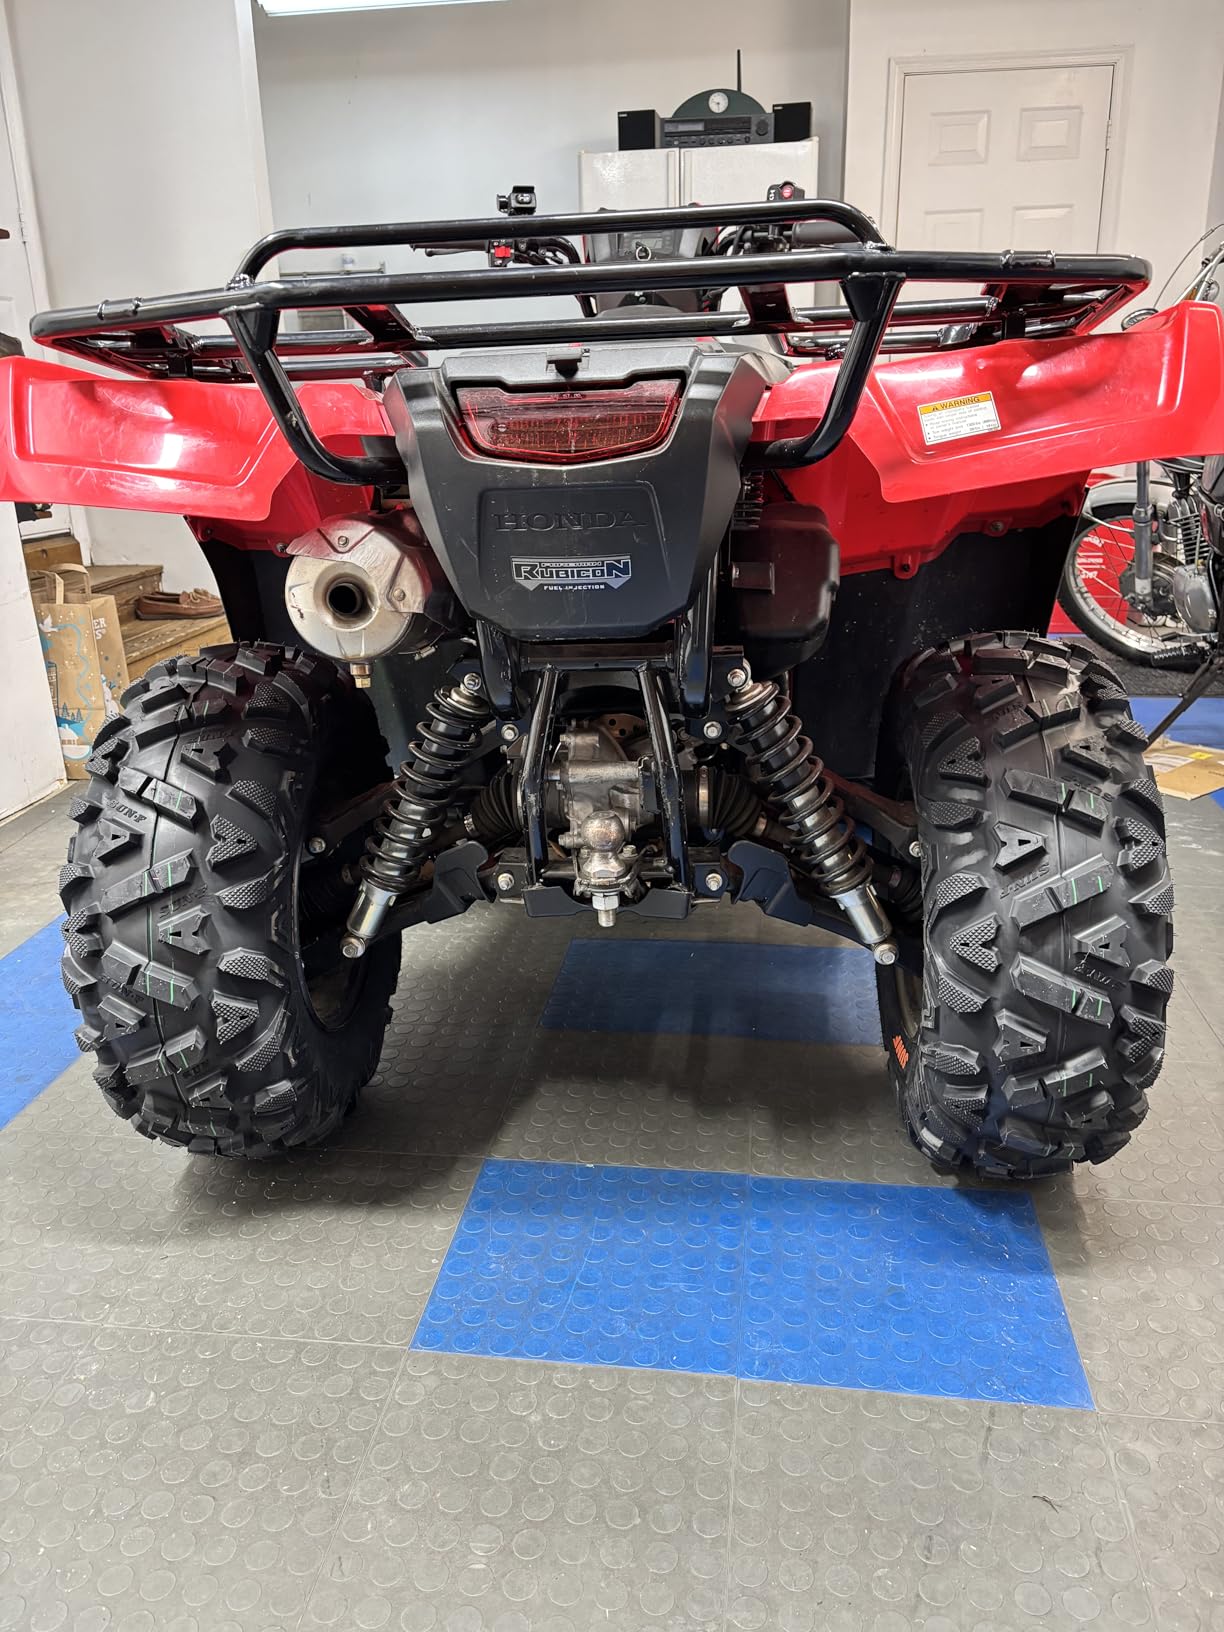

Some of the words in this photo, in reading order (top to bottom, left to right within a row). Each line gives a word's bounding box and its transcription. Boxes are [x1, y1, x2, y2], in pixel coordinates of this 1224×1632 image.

[939, 396, 980, 409] WARNING
[494, 511, 648, 531] HONDA
[512, 559, 632, 580] RUBICON
